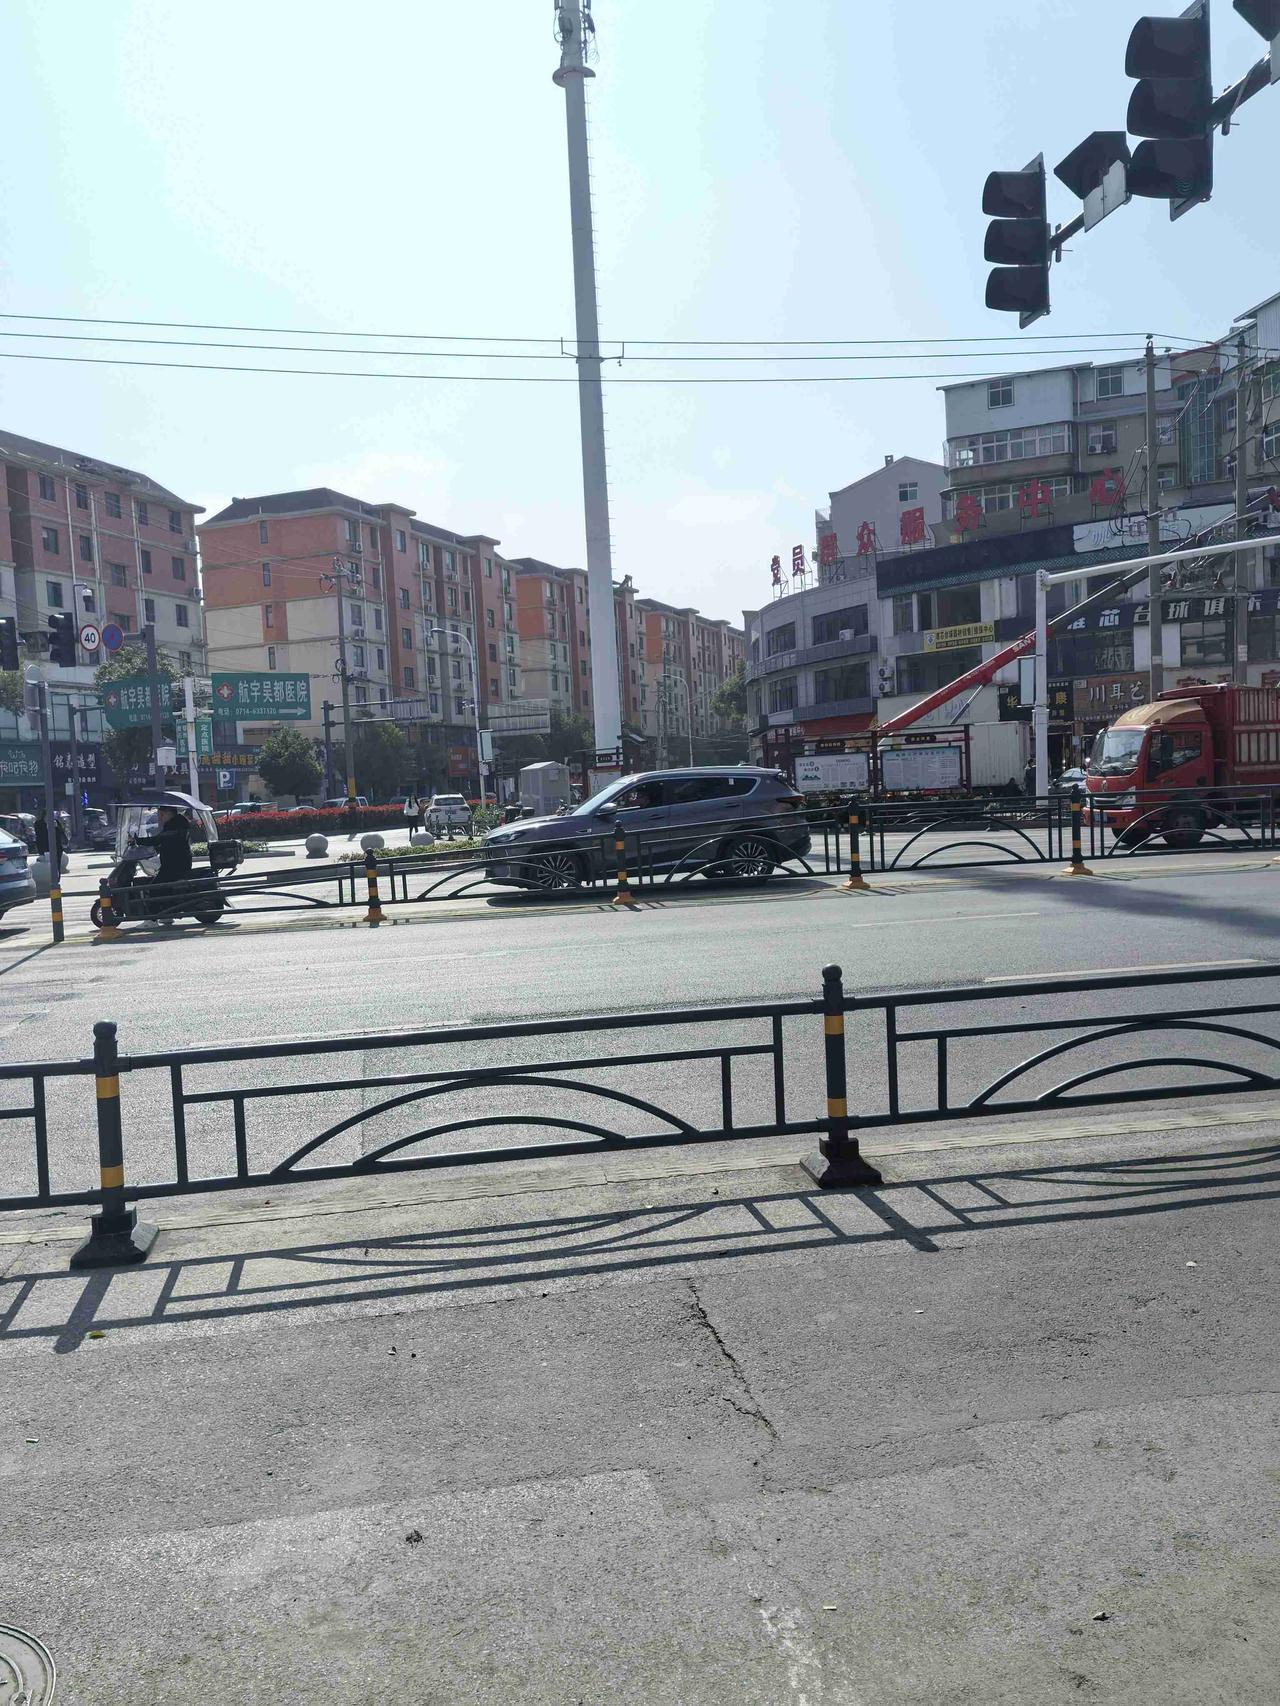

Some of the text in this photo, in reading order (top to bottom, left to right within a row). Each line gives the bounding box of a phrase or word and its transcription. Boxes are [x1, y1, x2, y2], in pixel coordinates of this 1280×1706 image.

[84, 632, 96, 643] 40
[1012, 633, 1036, 652] SANY
[120, 683, 170, 710] 航宇吴都院
[238, 680, 308, 703] 航宇吴都医院
